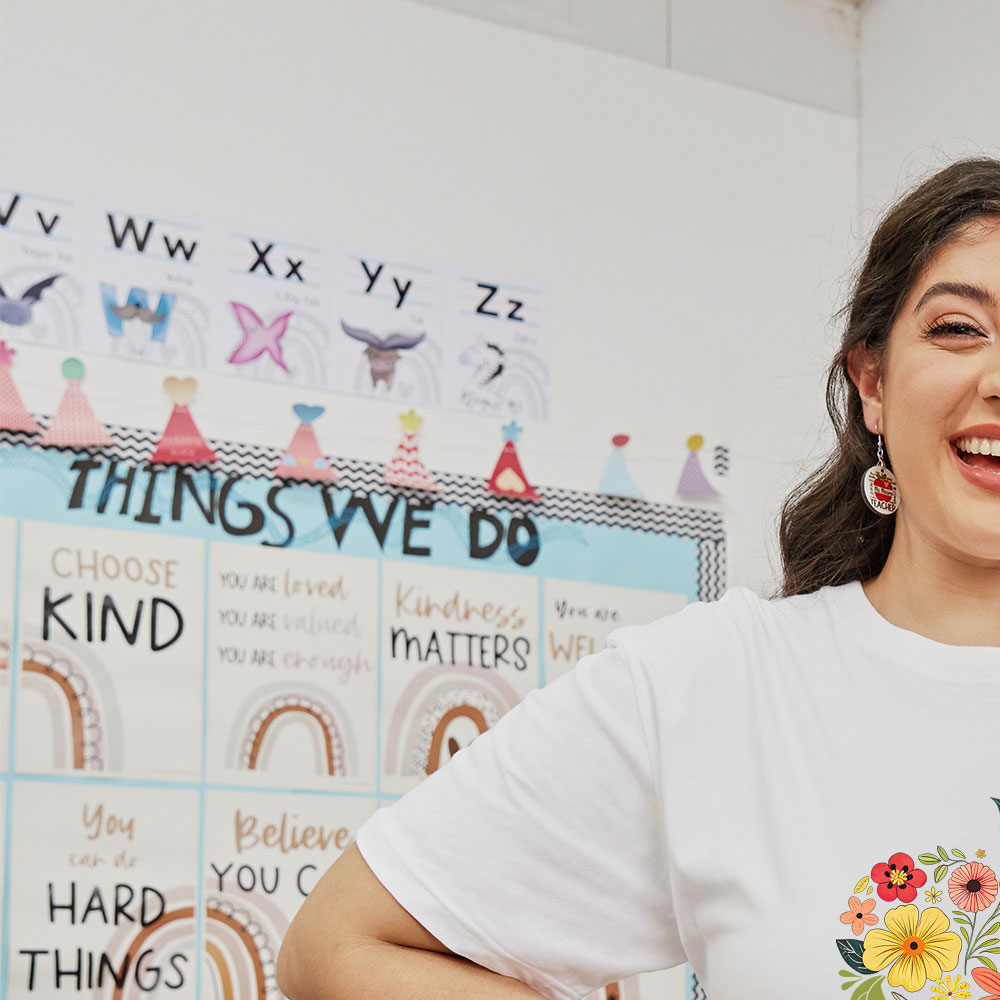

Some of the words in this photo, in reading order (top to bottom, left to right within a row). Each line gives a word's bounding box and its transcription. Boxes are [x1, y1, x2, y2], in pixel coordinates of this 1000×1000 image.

[67, 458, 296, 548] THINGS
[320, 487, 431, 557] WE
[469, 506, 541, 567] DO
[870, 499, 896, 512] TEACHER
[51, 547, 178, 590] CHOOSE
[218, 571, 248, 591] YOU
[253, 575, 277, 593] ARE
[284, 568, 348, 601] loved
[42, 585, 184, 652] KIND
[218, 609, 247, 628] YOU
[252, 610, 276, 630] ARE
[395, 582, 526, 630] Kindness
[218, 646, 247, 665] YOU
[251, 647, 275, 668] ARE
[82, 803, 135, 840] You
[233, 809, 350, 855] Believe
[211, 862, 280, 895] YOU
[48, 881, 166, 928] HARD
[19, 948, 189, 993] THINGS
